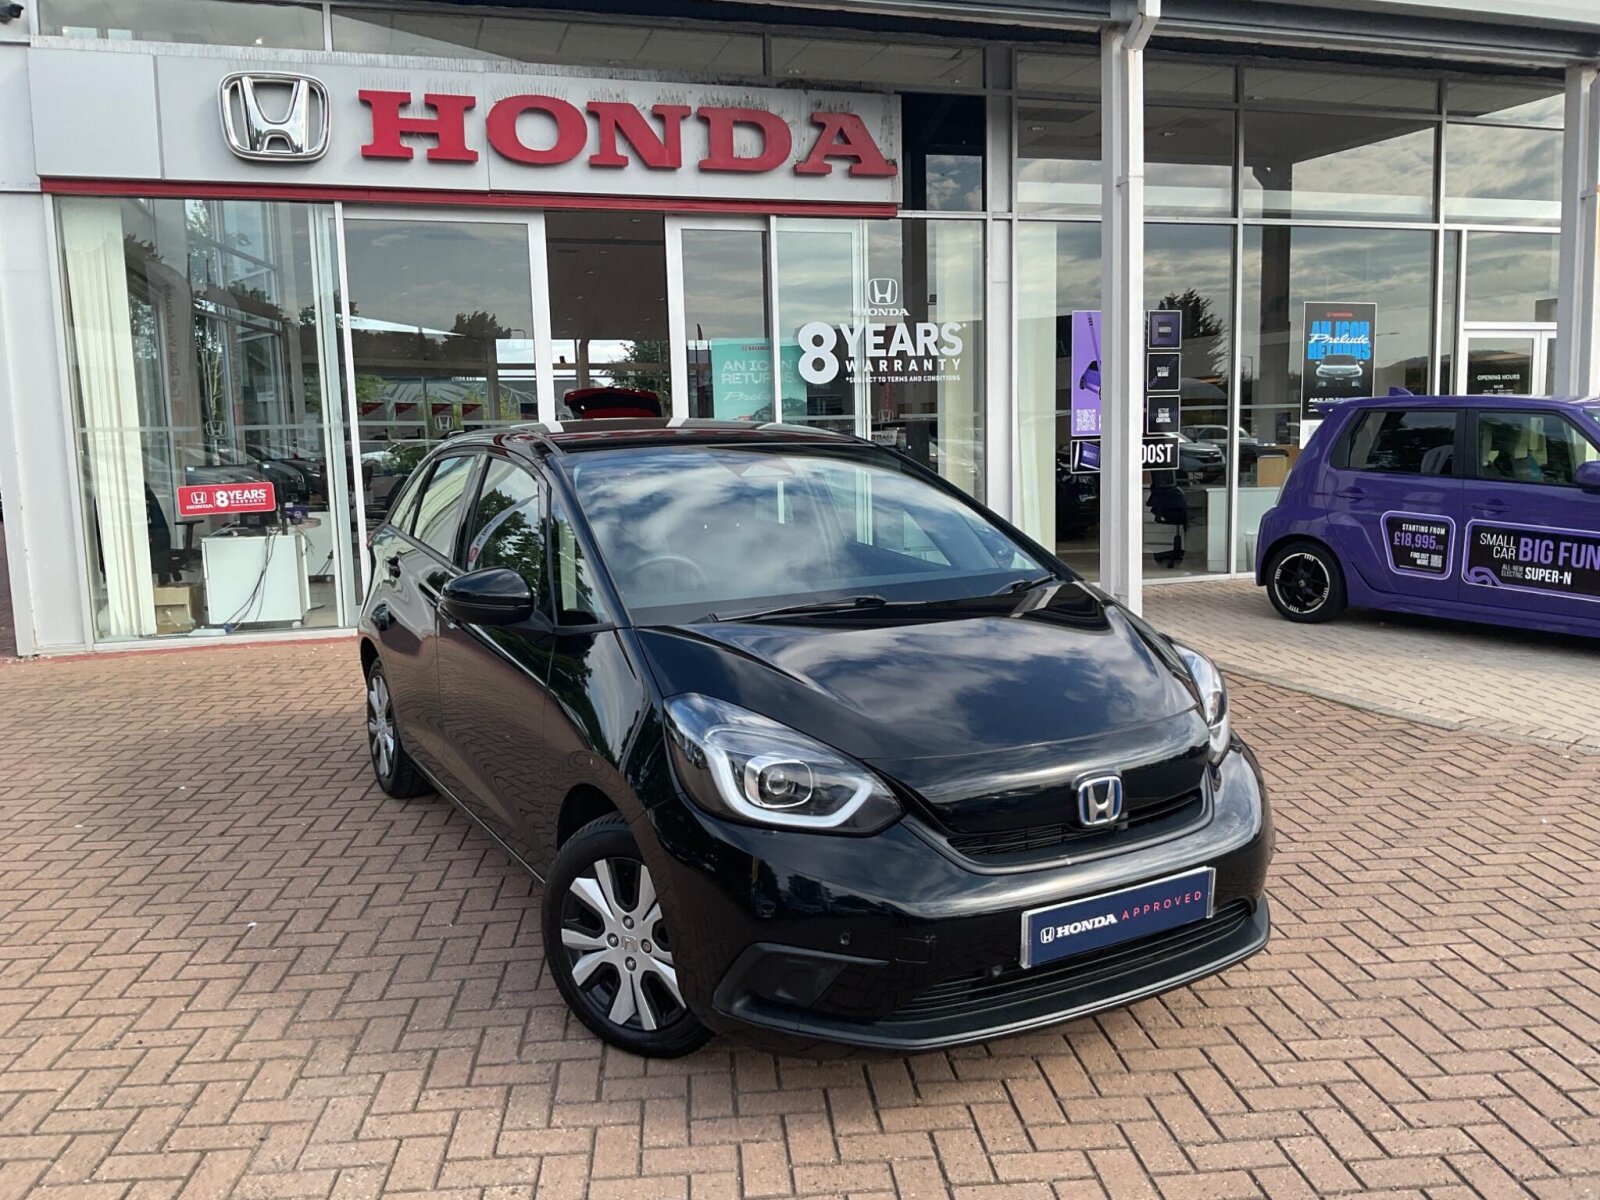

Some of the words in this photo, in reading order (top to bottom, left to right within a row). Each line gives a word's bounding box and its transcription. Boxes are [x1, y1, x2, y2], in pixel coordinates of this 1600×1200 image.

[358, 89, 898, 176] HONDA
[1308, 333, 1370, 344] Prelude
[797, 321, 839, 385] 8
[722, 360, 746, 372] AN
[748, 360, 792, 372] ICN
[845, 358, 961, 373] WARRANTY
[923, 373, 961, 381] CONDITIONS
[1142, 444, 1174, 463] OOST
[215, 490, 229, 507] 8
[227, 490, 266, 500] YEARS
[1402, 523, 1428, 533] STARTING
[1429, 526, 1446, 535] FROM
[1393, 531, 1437, 549] £18,995
[1479, 533, 1516, 548] SMALL
[1493, 546, 1516, 560] CAR
[1518, 537, 1554, 564] BIG
[1558, 541, 1600, 571] FUN
[1524, 566, 1572, 585] SUPER-N
[1056, 913, 1118, 938] HONDA
[1121, 891, 1202, 920] APPROVED
